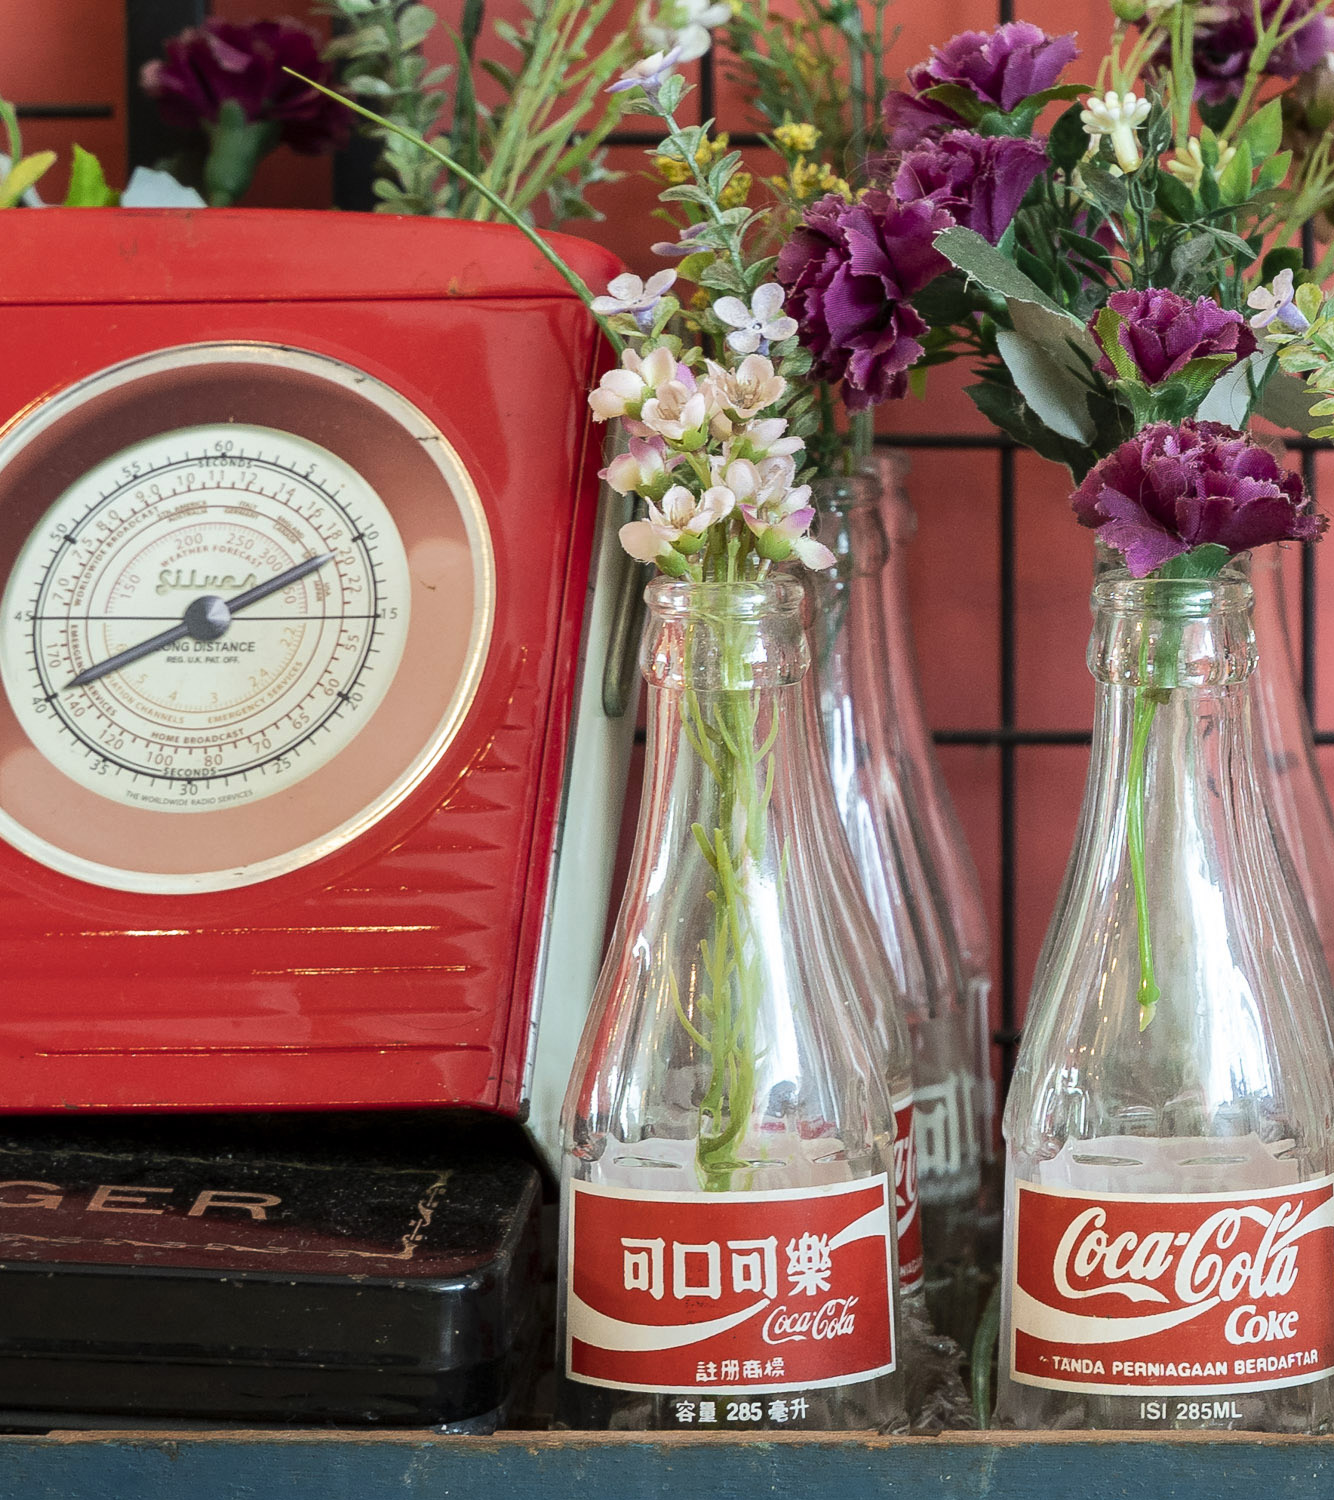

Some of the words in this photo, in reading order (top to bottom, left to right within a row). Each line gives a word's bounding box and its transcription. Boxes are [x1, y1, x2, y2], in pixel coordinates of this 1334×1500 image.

[214, 440, 234, 452] 60
[122, 461, 142, 478] 55
[198, 458, 253, 470] SECONDS
[309, 463, 318, 475] 5
[177, 473, 196, 486] 10
[210, 470, 225, 481] 11
[241, 471, 258, 486] 12
[279, 483, 296, 500] 14
[307, 502, 325, 519] 16
[50, 523, 68, 542] 50
[327, 523, 343, 540] 18
[364, 523, 379, 541] 10
[176, 533, 203, 550] 200
[226, 533, 254, 550] 250
[73, 550, 108, 606] WORLDWIDE
[106, 506, 160, 549] BROADCAST
[160, 545, 209, 568] WEATHER
[213, 545, 262, 568] FORECAST
[120, 574, 142, 600] 150
[349, 575, 364, 593] 22
[380, 608, 398, 619] 15
[46, 643, 62, 668] 170
[193, 641, 256, 653] DISTANCE
[207, 698, 267, 725] EMERGENCY
[266, 660, 303, 699] SERVICES
[323, 678, 341, 697] 60
[32, 697, 49, 714] 40
[345, 692, 365, 711] 20
[292, 712, 311, 731] 65
[98, 729, 125, 751] 120
[151, 731, 180, 744] HOME
[182, 728, 245, 744] BROADCAST
[253, 738, 272, 755] 70
[89, 758, 110, 776] 35
[147, 751, 174, 767] 100
[204, 753, 223, 767] 80
[273, 759, 292, 775] 25
[163, 768, 218, 778] SECONDS
[179, 783, 199, 796] 30
[1053, 1199, 1304, 1304] Coca-Cola
[620, 1231, 833, 1301] 可口可樂
[762, 1295, 859, 1345] Coca-Cola
[1224, 1305, 1300, 1345] Coke
[1052, 1355, 1106, 1375] TANDA
[1112, 1360, 1228, 1377] PERNIAGAAN
[1234, 1348, 1319, 1375] BERDAFTAR
[675, 1400, 718, 1423] 容量
[726, 1402, 763, 1422] 285
[767, 1397, 810, 1423] 毫升
[1140, 1402, 1167, 1420] ISI
[1176, 1401, 1243, 1420] 285ML
